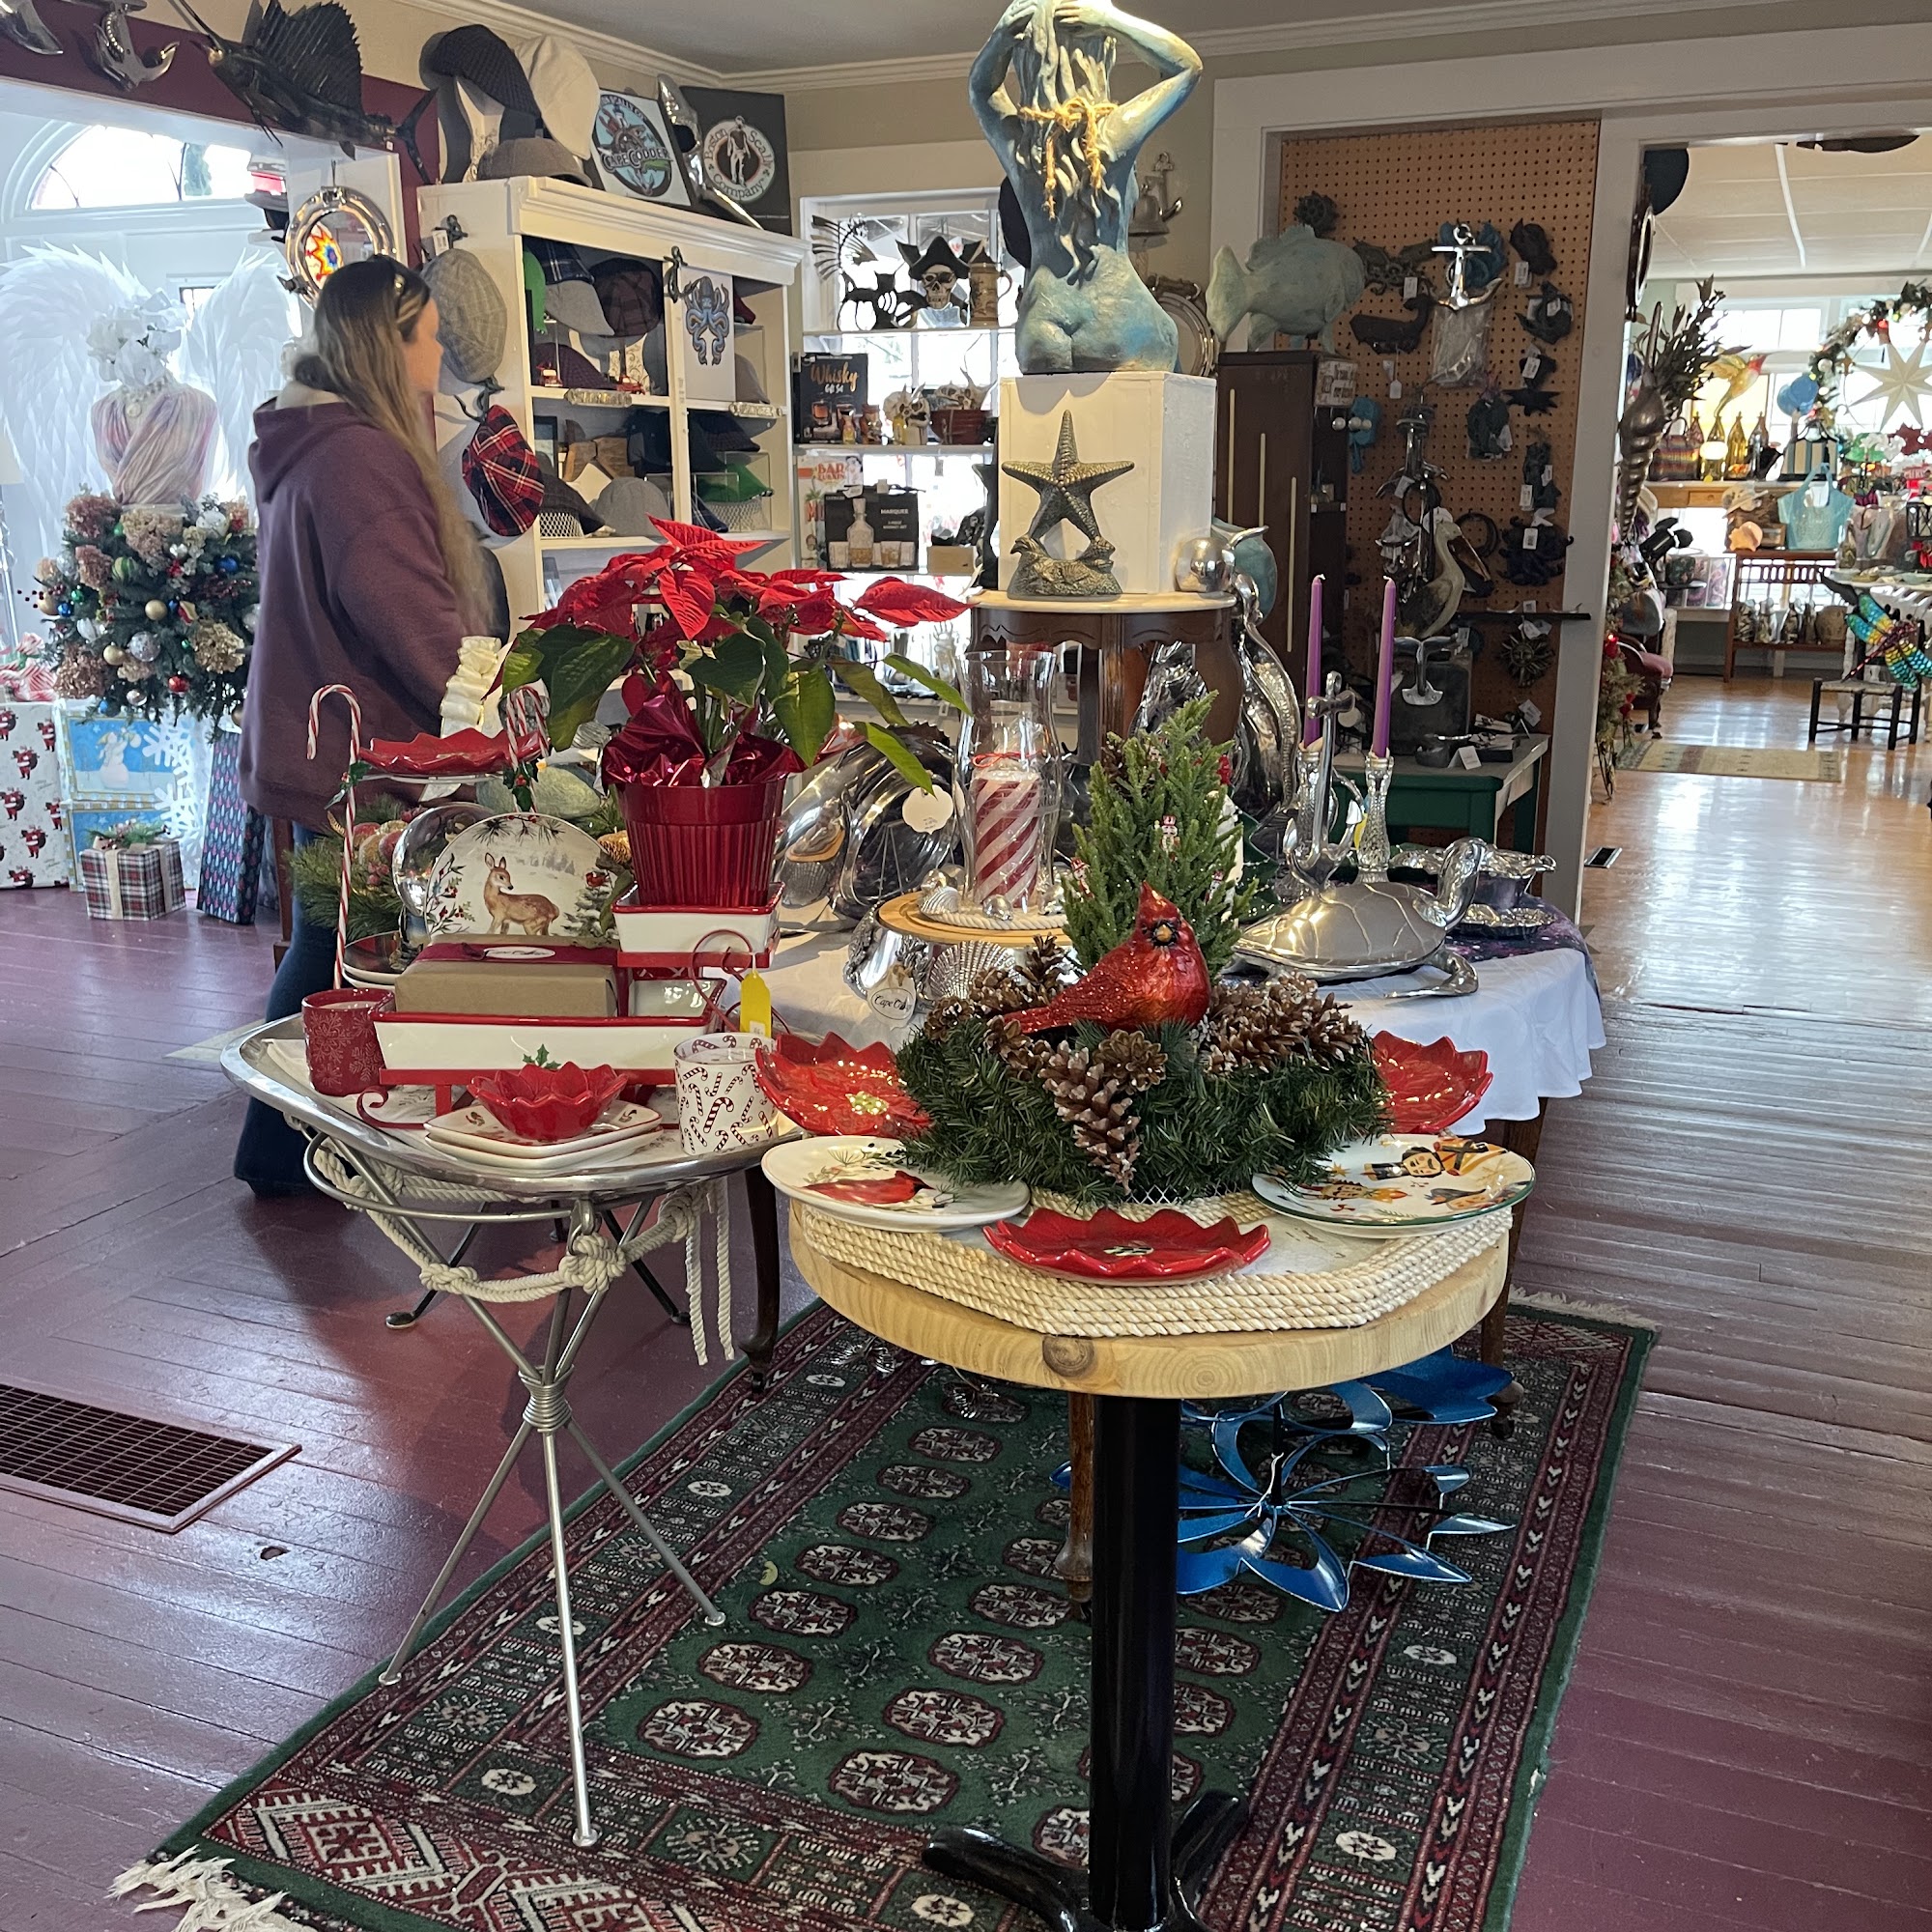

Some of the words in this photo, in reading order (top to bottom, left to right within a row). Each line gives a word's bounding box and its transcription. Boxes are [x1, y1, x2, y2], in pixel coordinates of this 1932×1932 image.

[600, 153, 630, 174] CAPE
[627, 147, 673, 169] CODDER
[703, 128, 728, 160] Boston
[748, 129, 774, 170] Scally
[713, 173, 765, 201] Company
[810, 361, 860, 392] Whisky
[817, 463, 845, 474] BAR
